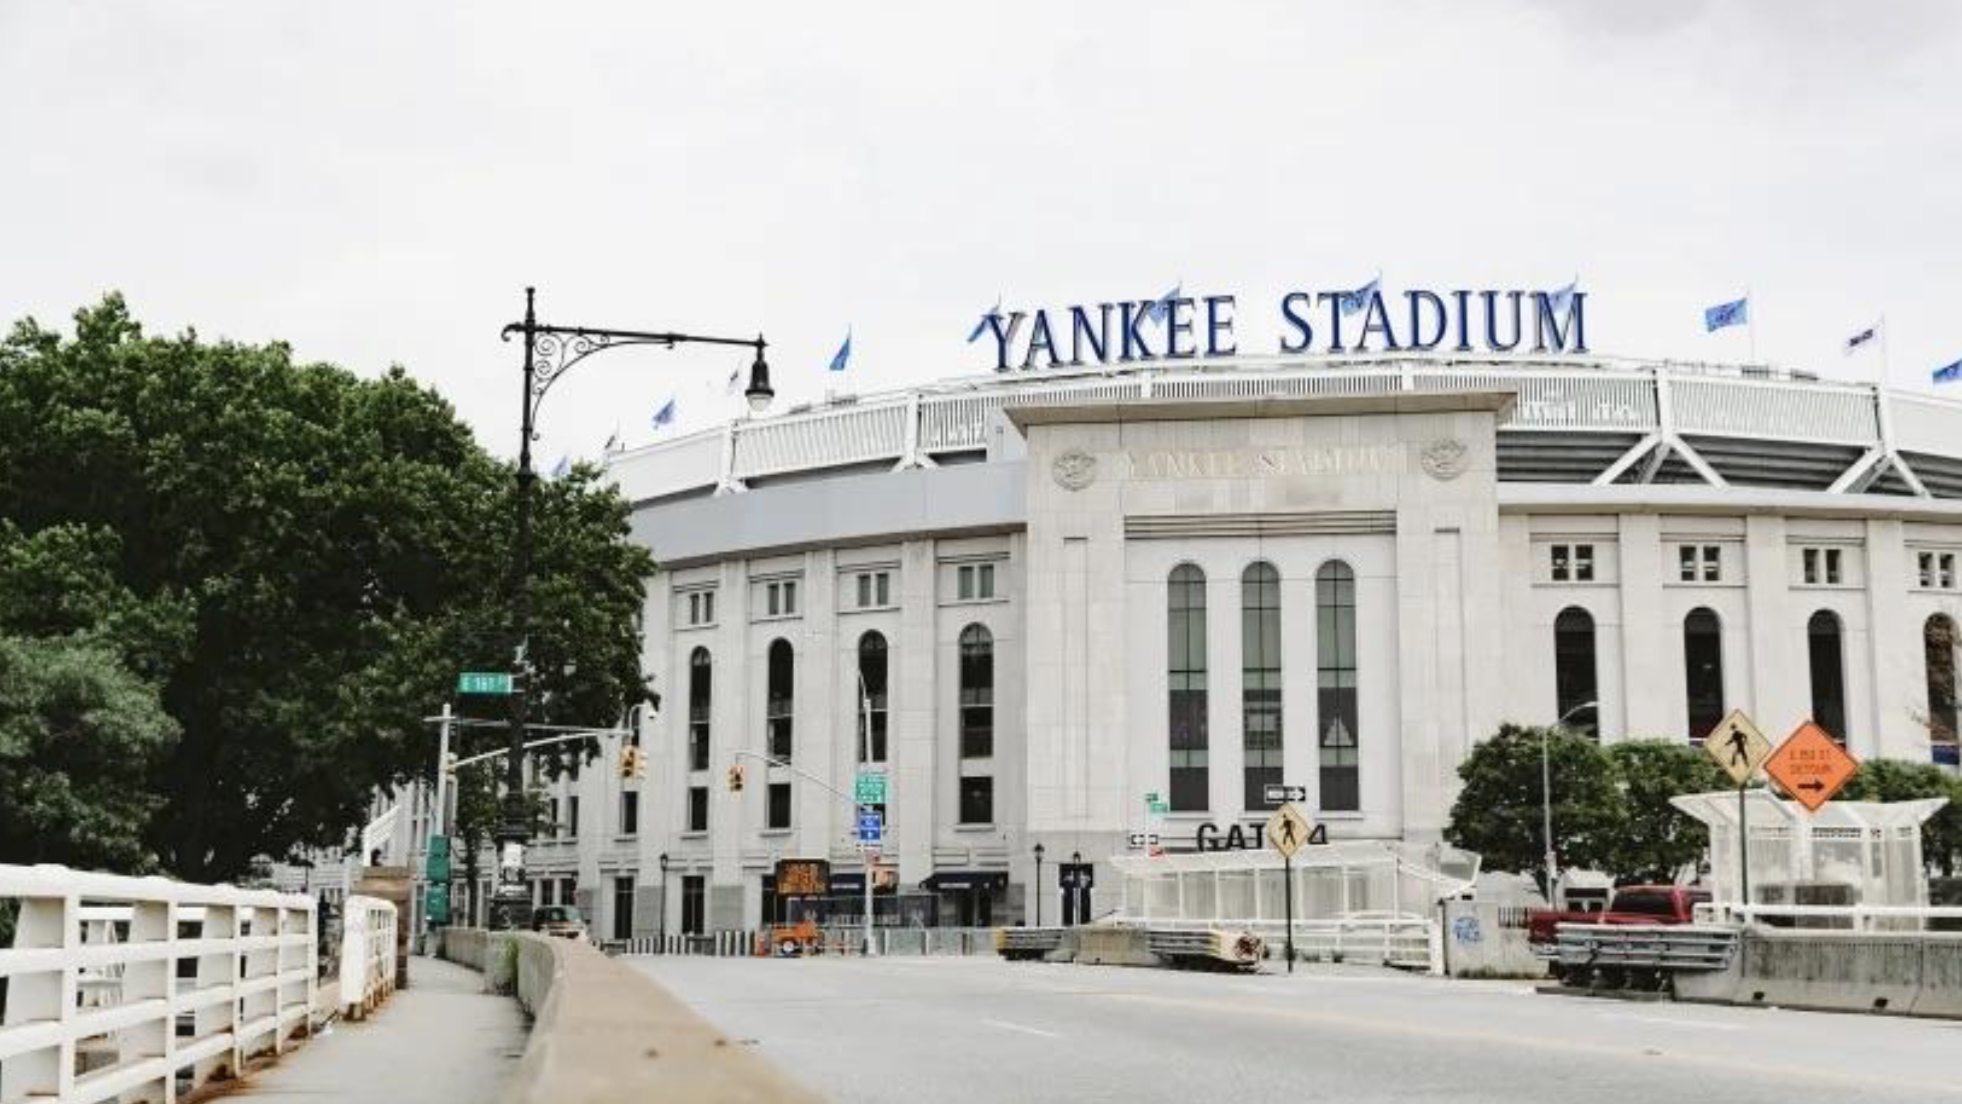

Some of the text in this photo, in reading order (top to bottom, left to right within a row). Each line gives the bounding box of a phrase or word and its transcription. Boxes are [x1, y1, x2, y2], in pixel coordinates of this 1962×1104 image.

[981, 289, 1589, 372] YANKEE STADIUM
[1196, 822, 1328, 852] GAT 4
